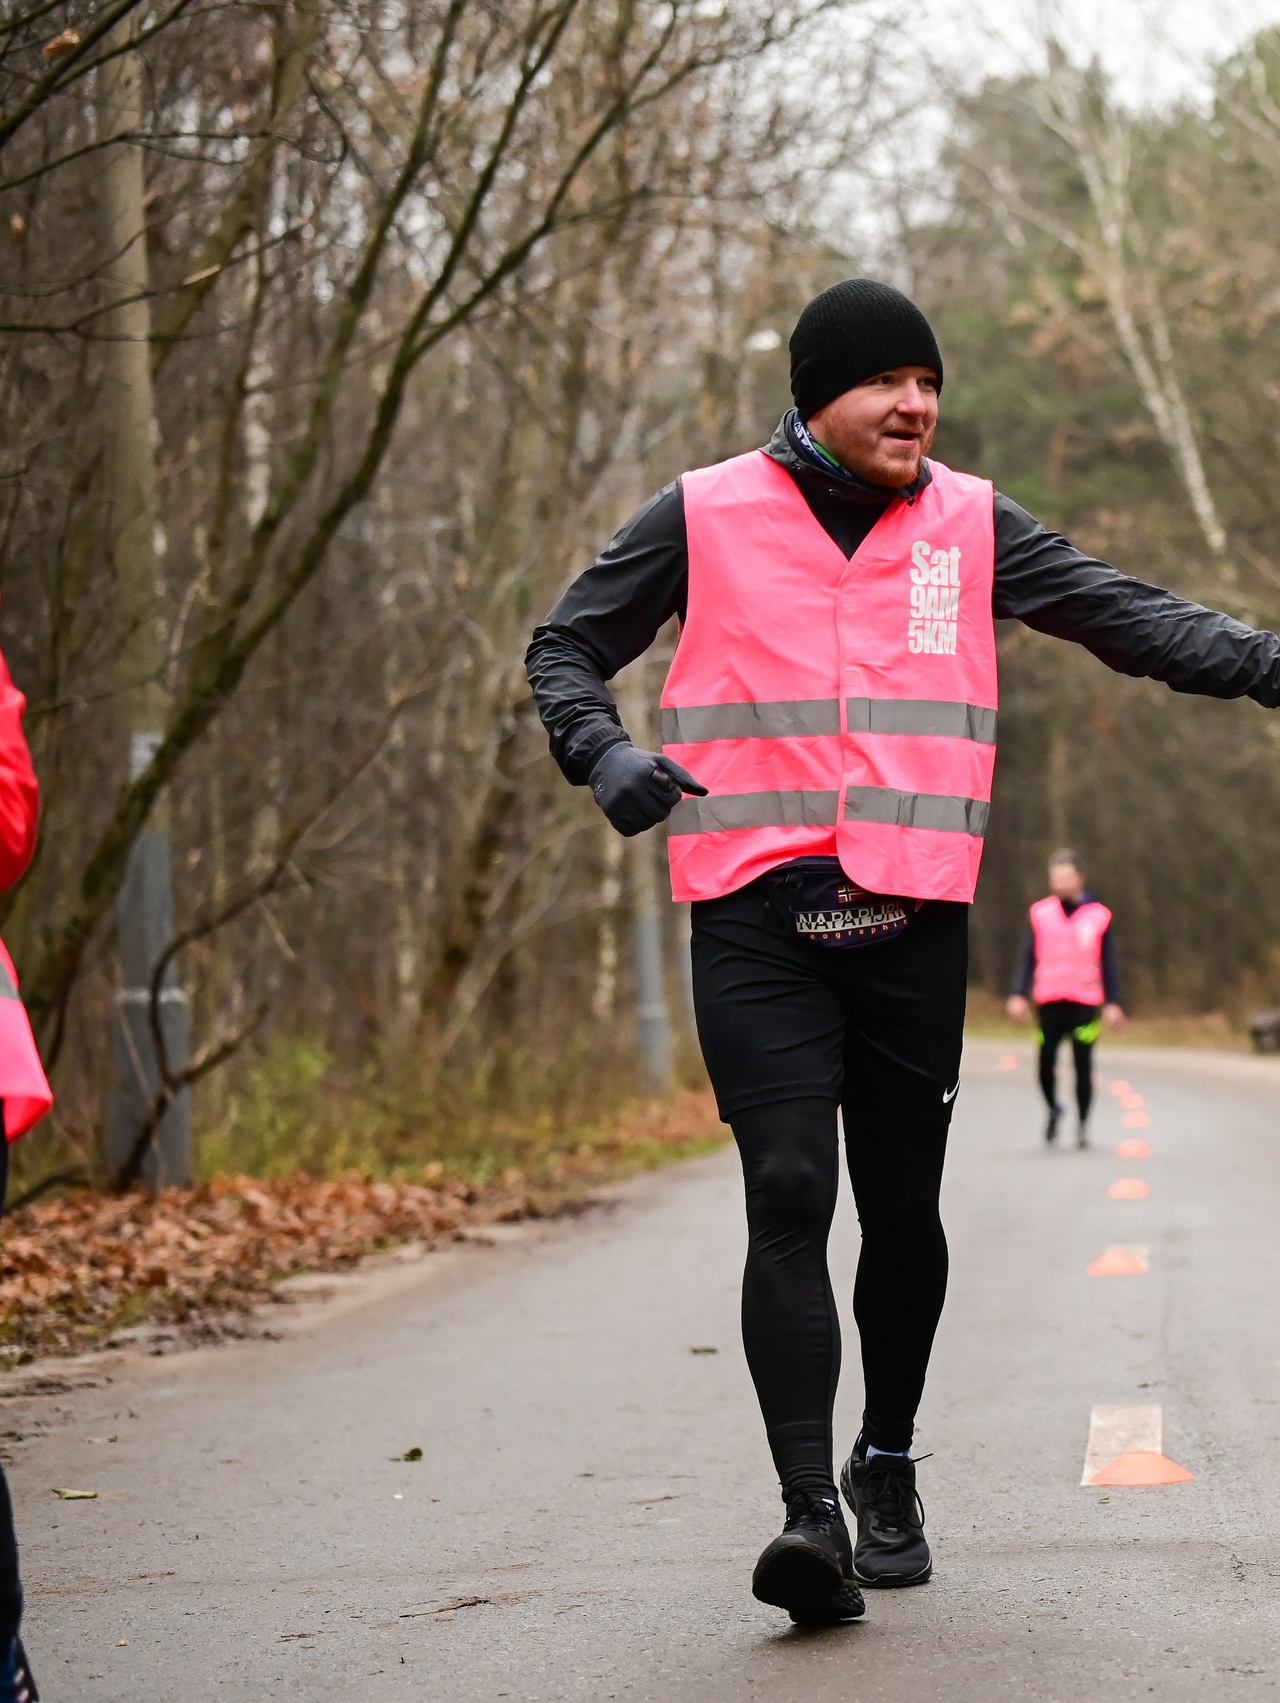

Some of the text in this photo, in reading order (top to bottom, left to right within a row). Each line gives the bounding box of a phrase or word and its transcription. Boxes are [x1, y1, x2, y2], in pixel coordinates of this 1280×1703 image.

[910, 541, 961, 586] Sat
[910, 585, 960, 620] 9AM
[908, 620, 957, 655] 5KM
